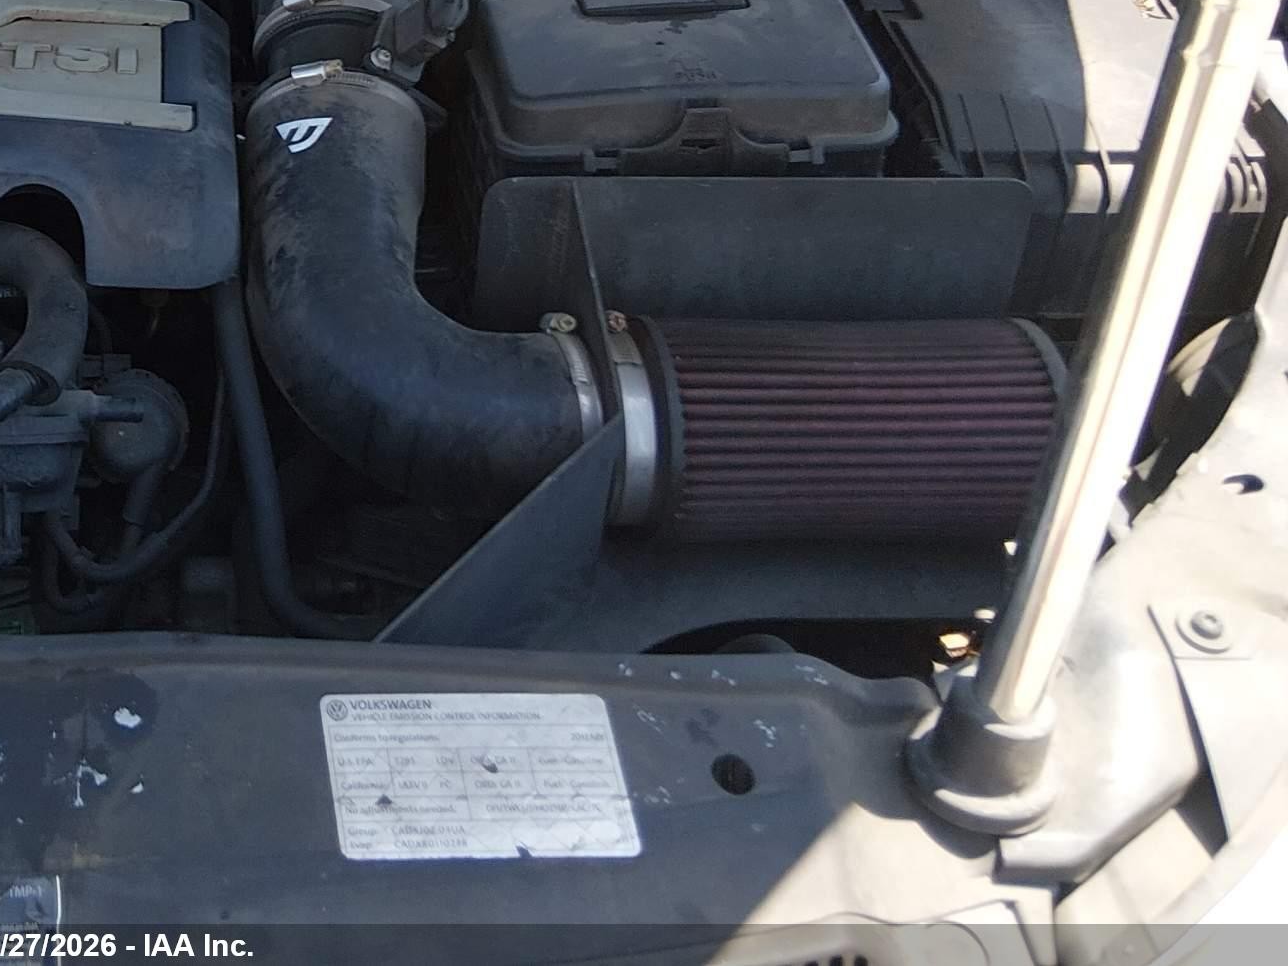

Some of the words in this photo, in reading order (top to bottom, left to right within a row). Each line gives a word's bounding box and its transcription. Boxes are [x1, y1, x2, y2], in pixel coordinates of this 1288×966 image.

[0, 41, 140, 75] TSI
[350, 698, 432, 710] VOLKSWAGEN
[352, 713, 387, 721] VEHICLE
[389, 713, 432, 721] EMISSION
[435, 713, 476, 721] CONTROL
[478, 712, 540, 721] INFORMATION
